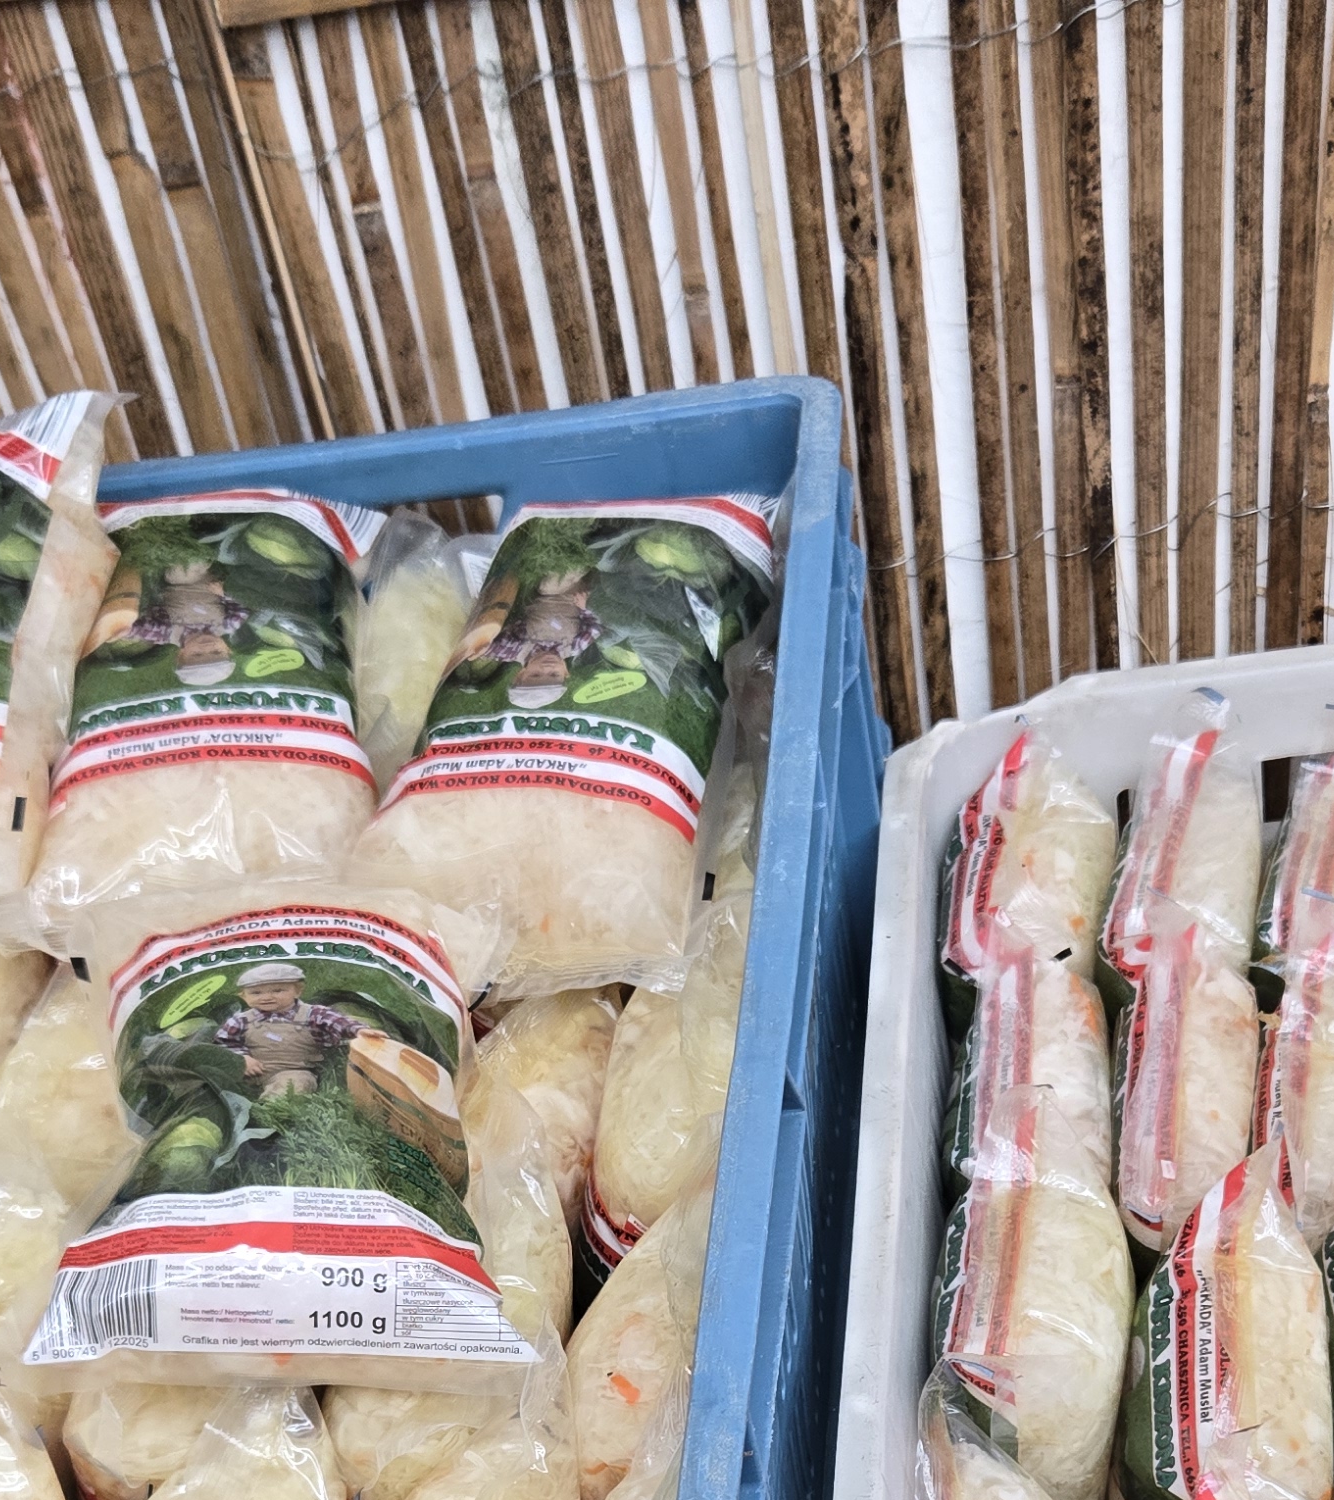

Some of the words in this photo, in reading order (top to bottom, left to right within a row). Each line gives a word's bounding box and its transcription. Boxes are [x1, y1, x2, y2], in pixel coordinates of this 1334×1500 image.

[190, 691, 338, 716] KAPUSTA
[116, 718, 214, 739] CHARSZNICA
[512, 716, 656, 755] KAPUSTA
[107, 741, 155, 760] Musiał
[158, 734, 201, 747] Adam
[431, 741, 525, 757] CHARSZNICA
[529, 741, 575, 751] 32-250
[207, 748, 350, 769] GOSPODARSTWO
[589, 746, 605, 757] 46
[420, 760, 462, 778] Musiał
[466, 758, 505, 768] Adam
[609, 751, 694, 804] SWOJCZANY
[505, 773, 652, 807] GOSPODARSTWO
[282, 918, 329, 926] Adam
[333, 919, 386, 937] Musiał
[140, 943, 291, 1000] KAPUSTA
[1174, 1263, 1185, 1278] 46
[373, 1272, 387, 1293] g
[309, 1311, 363, 1328] 1100
[372, 1317, 386, 1334] g
[32, 1351, 40, 1362] 5
[52, 1346, 98, 1360] 906749
[107, 1337, 149, 1349] 122025
[182, 1335, 220, 1346] Grafika
[222, 1335, 238, 1345] nie
[241, 1336, 259, 1347] jest
[261, 1337, 305, 1347] wiernym
[307, 1338, 401, 1349] odzwierciedleniem
[403, 1341, 457, 1352] zawartości
[460, 1344, 523, 1355] opakowania.
[1199, 1338, 1212, 1377] Adam
[1178, 1330, 1190, 1423] CHARSZNICA
[1199, 1378, 1212, 1423] Musiał
[1153, 1359, 1177, 1488] KISZONA
